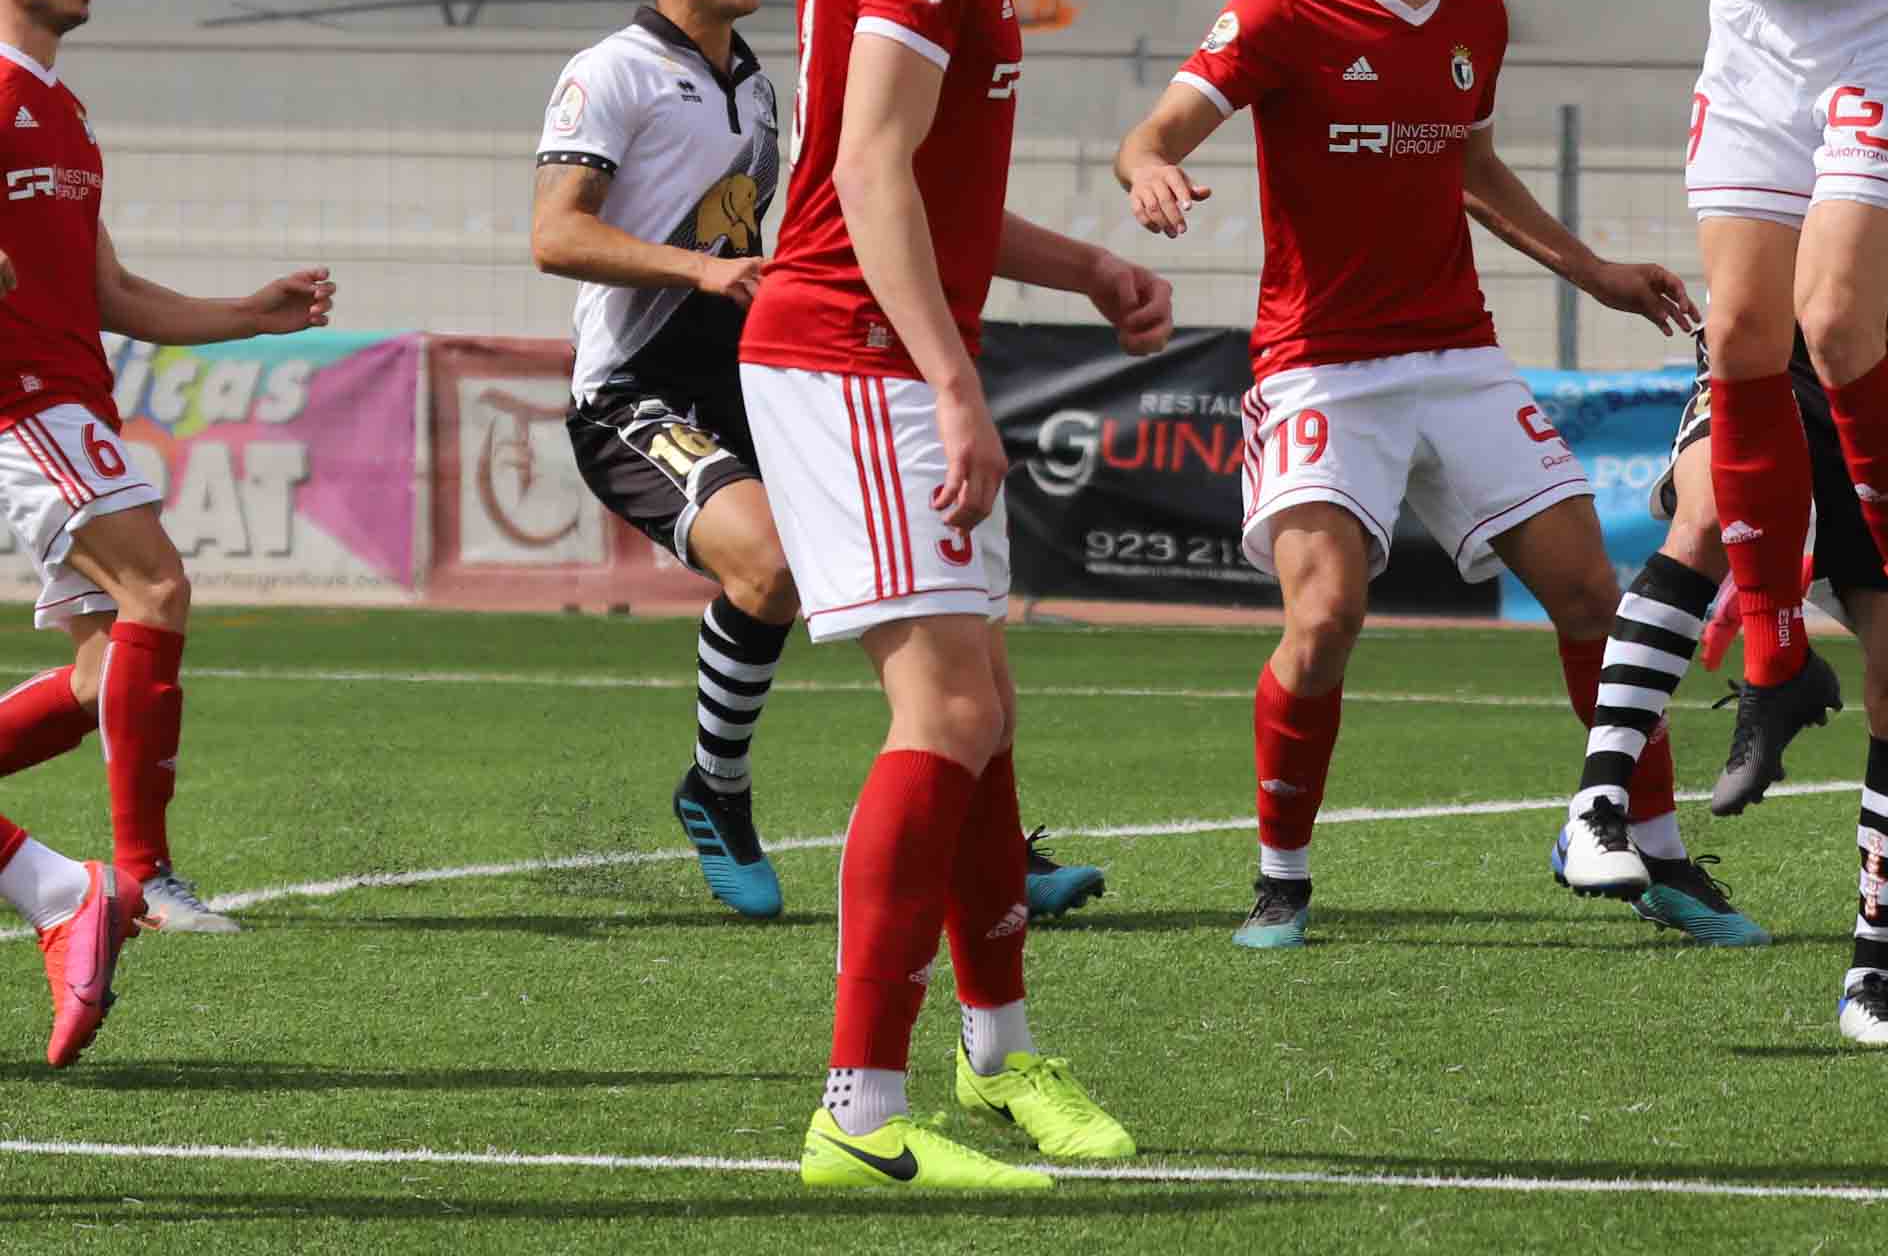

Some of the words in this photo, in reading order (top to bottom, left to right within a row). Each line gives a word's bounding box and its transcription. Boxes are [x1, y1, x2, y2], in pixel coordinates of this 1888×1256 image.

[1343, 72, 1378, 81] adidas
[1395, 139, 1447, 154] GROUP
[82, 423, 127, 480] 6
[1272, 407, 1329, 477] 19
[1086, 530, 1176, 562] 923
